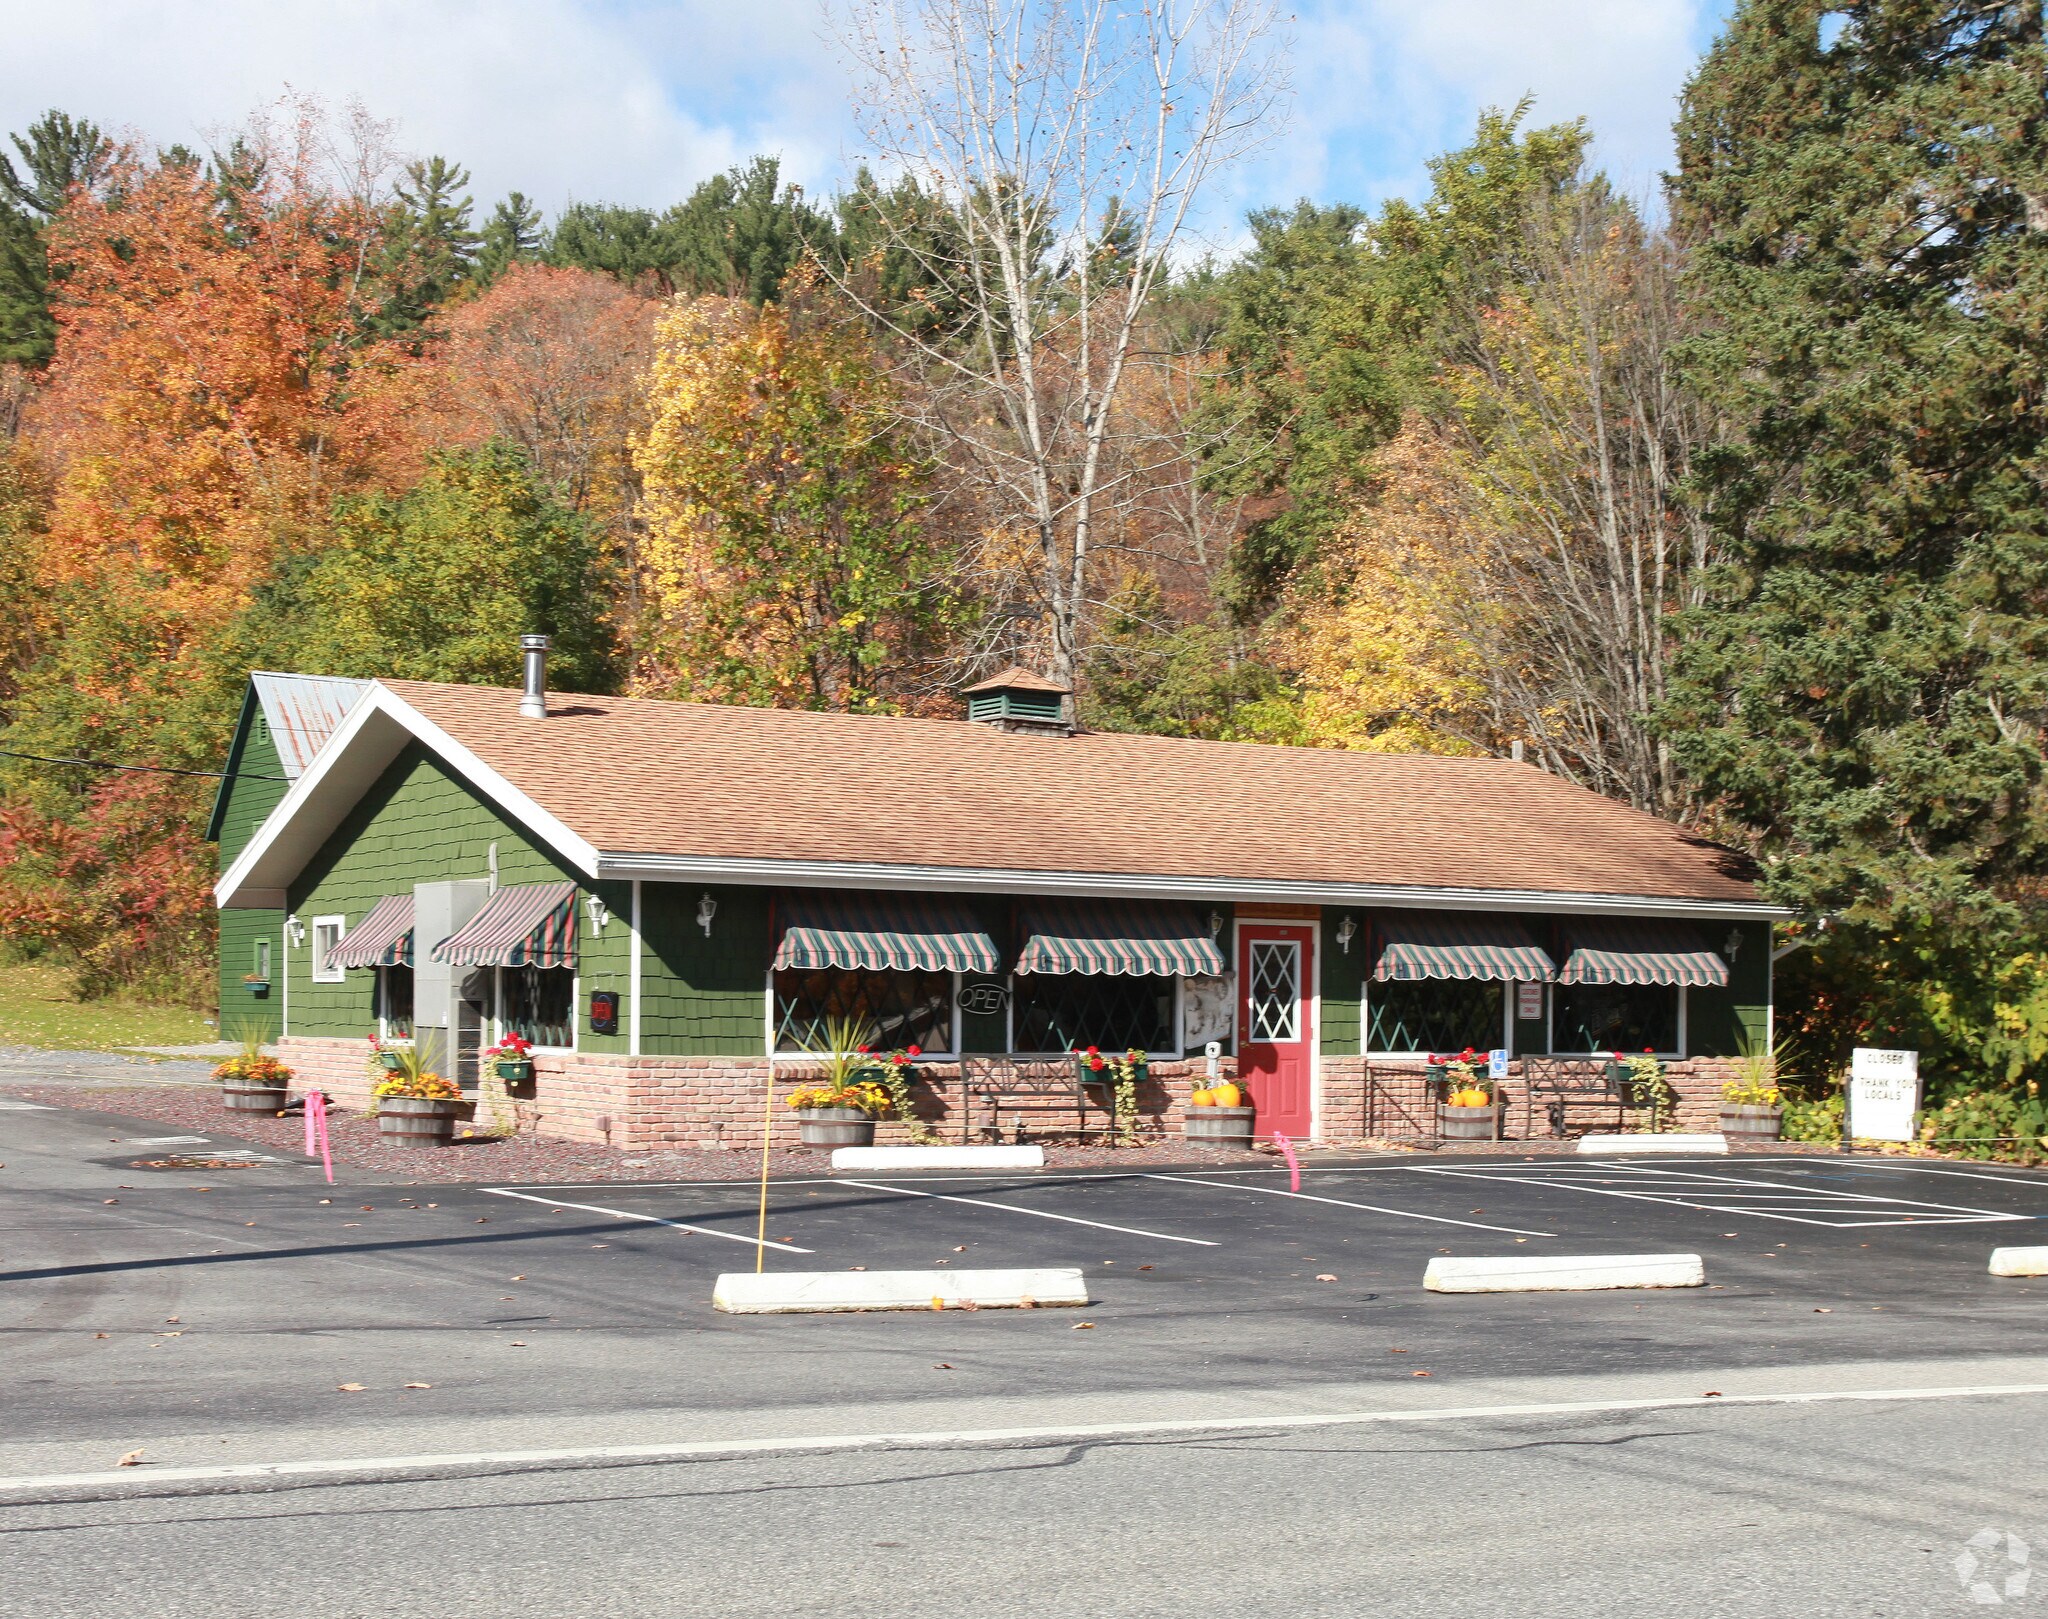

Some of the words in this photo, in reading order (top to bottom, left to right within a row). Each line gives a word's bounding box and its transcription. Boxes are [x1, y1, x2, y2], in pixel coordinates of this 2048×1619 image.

[958, 988, 1012, 1010] OPEN
[592, 1001, 613, 1020] OPEN
[1867, 1053, 1904, 1064] CLOSED
[1860, 1077, 1889, 1087] THANK
[1896, 1078, 1914, 1088] YOU
[1864, 1090, 1902, 1100] LOCALS
